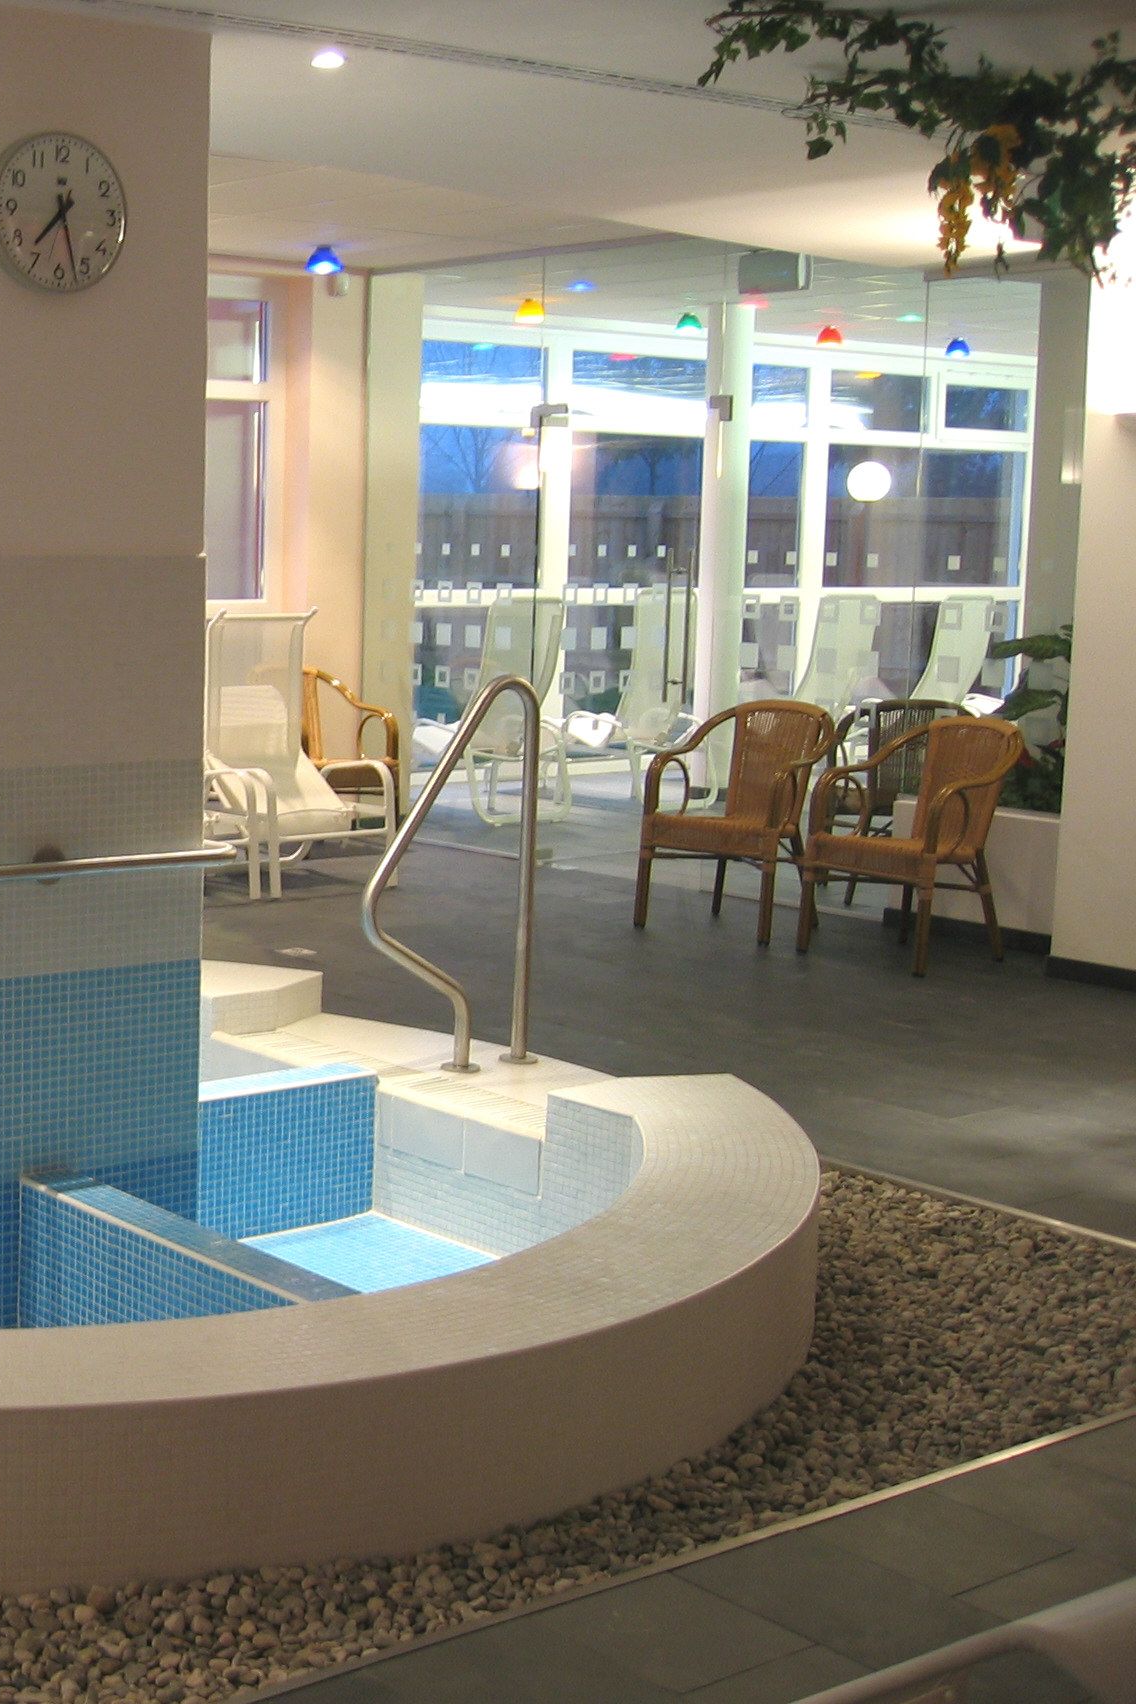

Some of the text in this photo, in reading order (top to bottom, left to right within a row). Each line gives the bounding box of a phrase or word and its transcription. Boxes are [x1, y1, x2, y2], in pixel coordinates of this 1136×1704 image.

[32, 149, 44, 169] 11
[54, 145, 70, 163] 12
[11, 169, 25, 188] 10
[97, 180, 110, 198] 2
[6, 198, 18, 216] 9
[106, 209, 116, 227] 3
[14, 228, 23, 247] 8
[95, 238, 107, 256] 4
[30, 251, 40, 270] 7
[79, 257, 90, 275] 5
[53, 263, 65, 280] 6
